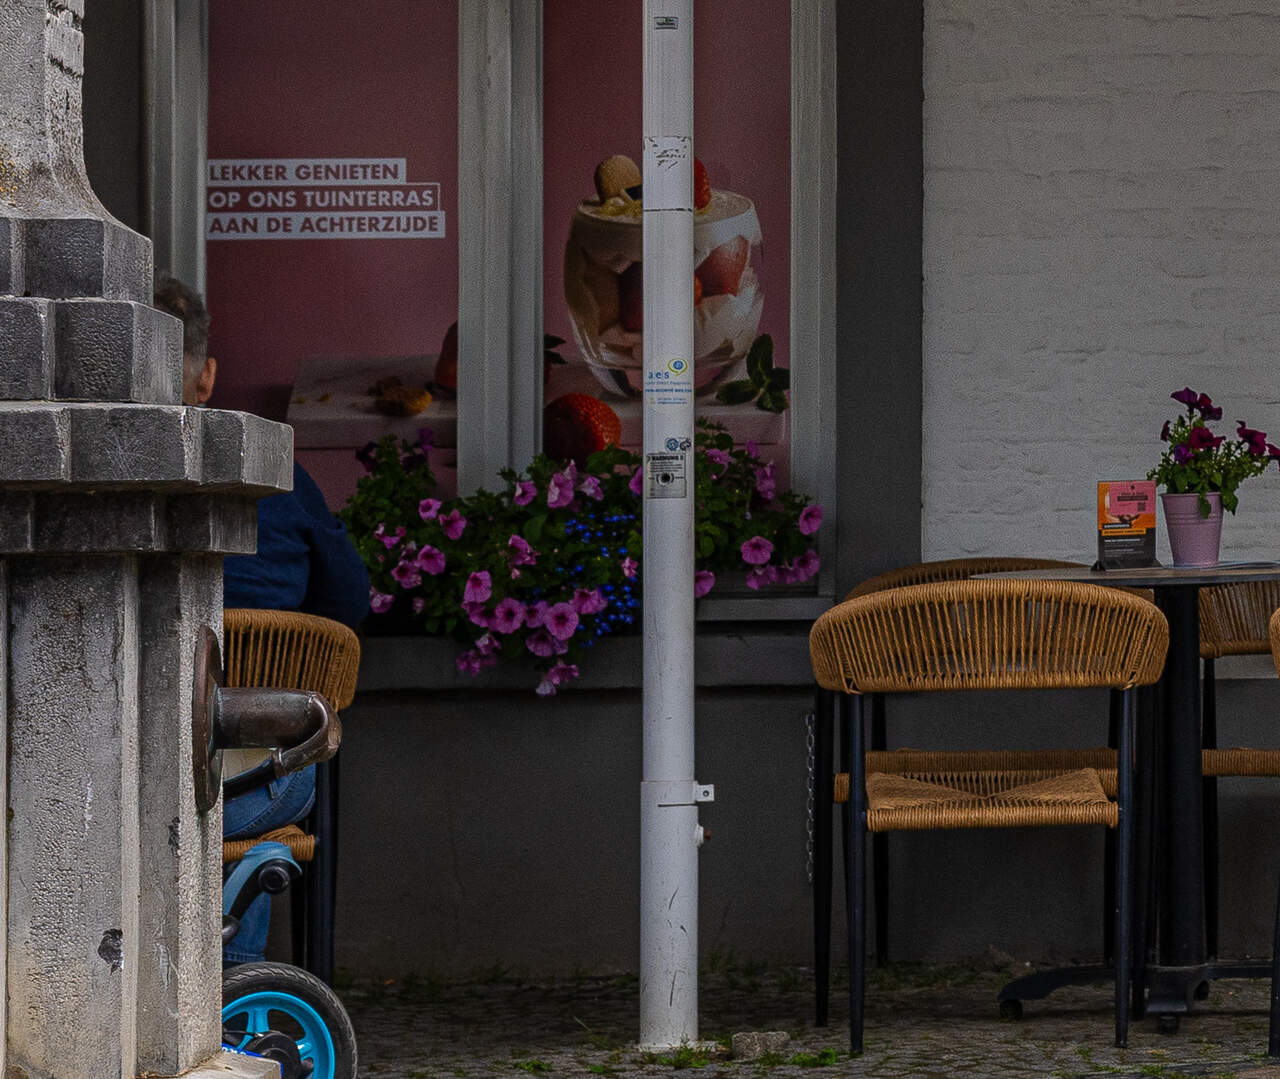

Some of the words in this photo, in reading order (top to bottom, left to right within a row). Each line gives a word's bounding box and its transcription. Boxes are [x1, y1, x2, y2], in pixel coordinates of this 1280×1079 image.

[209, 163, 288, 181] LEKKER
[294, 163, 399, 180] GENIETEN
[209, 191, 241, 208] OP
[248, 190, 297, 208] ONS
[304, 189, 433, 207] TUINTERRAS
[209, 216, 259, 234] AAN
[266, 216, 293, 233] DE
[300, 215, 438, 233] ACHTERZIJDE
